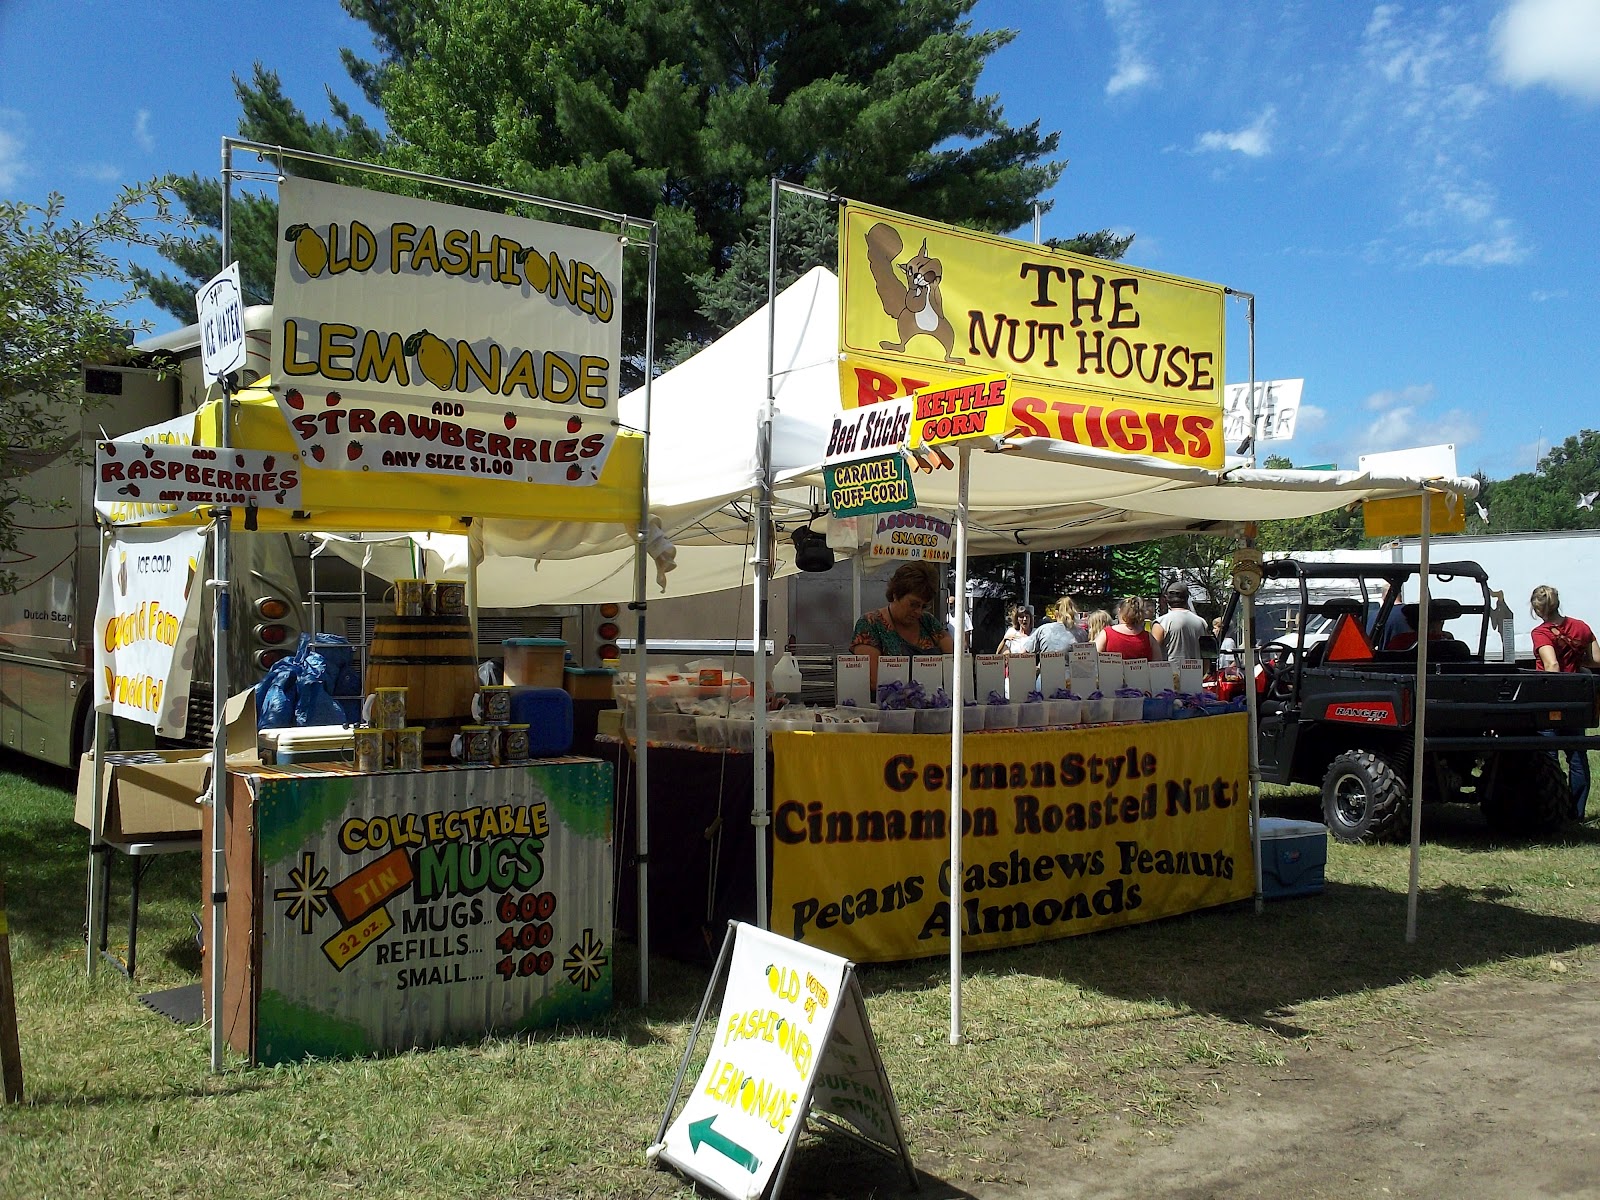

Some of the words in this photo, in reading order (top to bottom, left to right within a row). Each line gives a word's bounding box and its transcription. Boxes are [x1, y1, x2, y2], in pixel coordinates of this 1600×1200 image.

[288, 220, 377, 278] OLD
[391, 222, 613, 323] FASHIONED
[1020, 262, 1140, 330] THE
[204, 319, 216, 358] ICE
[216, 301, 241, 350] WATER
[283, 319, 609, 409] LEMONADE
[967, 310, 1065, 368] NUT
[1076, 330, 1214, 391] HOUSE
[431, 401, 464, 417] ADD
[916, 380, 1006, 420] KETTLE
[292, 408, 605, 463] STRAWBERRIES
[826, 412, 864, 457] Beef
[861, 406, 910, 450] Sticks
[922, 411, 987, 441] CORN
[1012, 400, 1214, 458] STICKS
[192, 449, 217, 460] ADD
[382, 449, 420, 468] ANY
[424, 451, 466, 471] SIZE
[470, 458, 513, 475] $1.00
[835, 459, 897, 486] CARAMEL
[101, 460, 298, 491] RASPBERRIES
[832, 481, 908, 509] PUFF-CORN
[159, 490, 184, 501] ANY
[187, 491, 213, 502] SIZE
[892, 531, 938, 547] SNACKS
[911, 548, 920, 557] OR
[137, 555, 150, 574] ICE
[151, 554, 172, 573] COLD
[24, 609, 49, 620] Dutch
[51, 611, 73, 622] Star
[1335, 707, 1388, 719] RANGER
[338, 802, 550, 854] COLLECTABLE
[774, 801, 999, 845] Cinnamon
[1013, 782, 1157, 835] Roasted
[353, 866, 399, 905] TIN
[414, 838, 545, 903] MUGS
[496, 891, 557, 923] 6.00
[792, 873, 925, 941] Pecans
[938, 849, 1105, 897] Cashews
[1115, 840, 1235, 880] Peanuts
[918, 878, 1142, 940] Almonds
[339, 934, 361, 955] 32
[496, 921, 553, 954] 4.00
[496, 950, 554, 981] 4.00
[767, 963, 800, 1003] OLD
[724, 1009, 812, 1081] FASHIONED
[704, 1059, 797, 1134] LEMONADE
